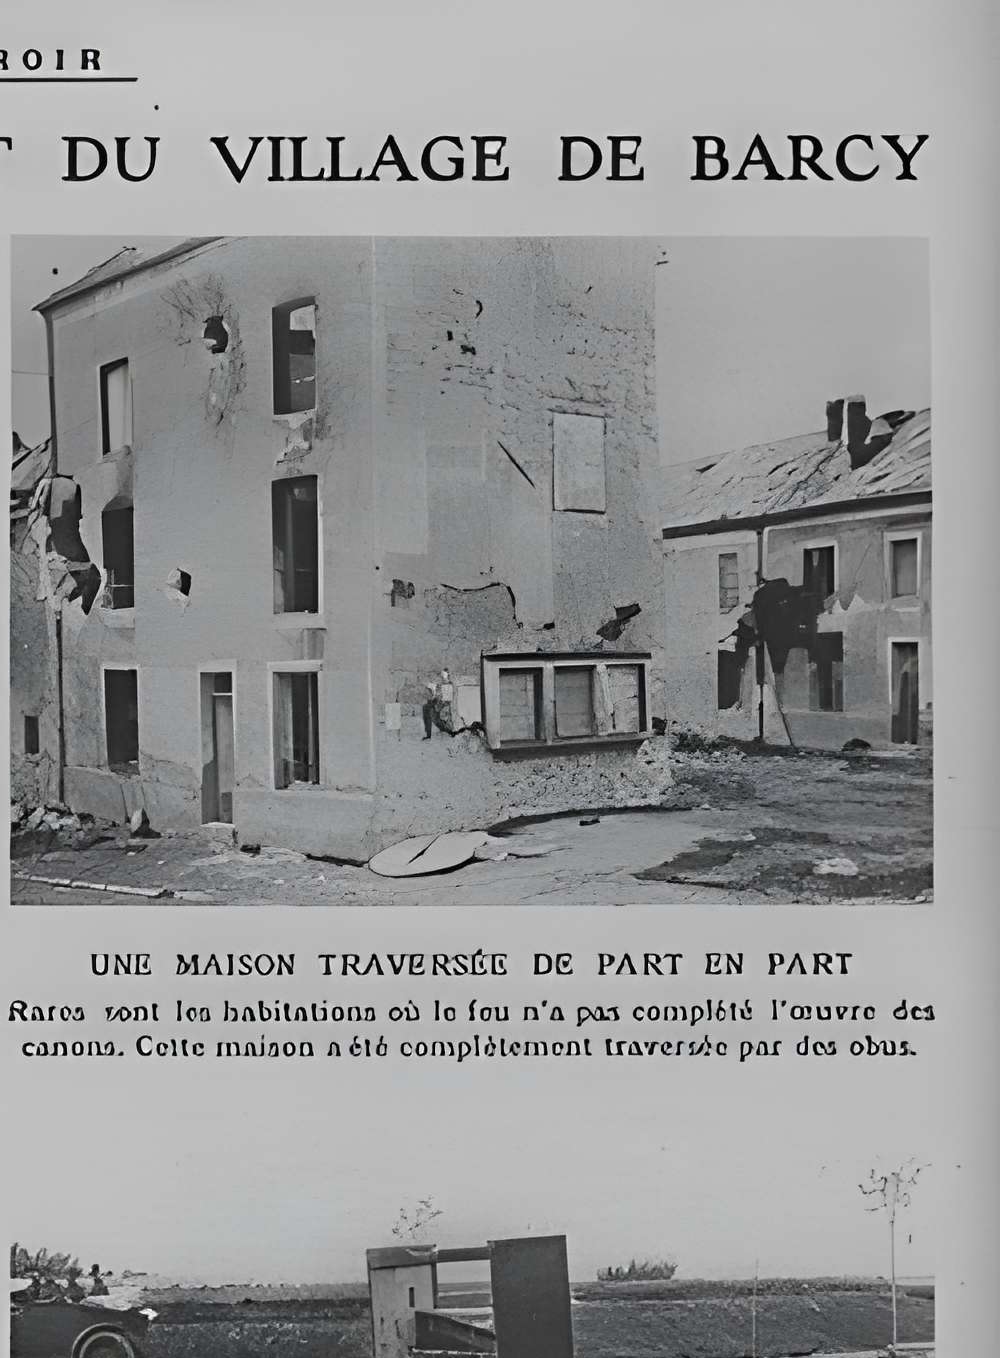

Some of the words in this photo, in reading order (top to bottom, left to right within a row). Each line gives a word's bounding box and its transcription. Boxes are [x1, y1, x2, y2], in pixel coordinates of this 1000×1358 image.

[60, 135, 161, 183] DU
[209, 133, 510, 185] VILLAGE
[557, 135, 645, 182] DE
[689, 132, 930, 183] BARCY
[90, 953, 153, 977] UNE
[175, 953, 296, 977] MAISON
[317, 947, 508, 977] TRAVERSÉE
[533, 952, 574, 976] DE
[597, 952, 684, 976] PART
[704, 952, 744, 976] EN
[767, 952, 854, 976] PART
